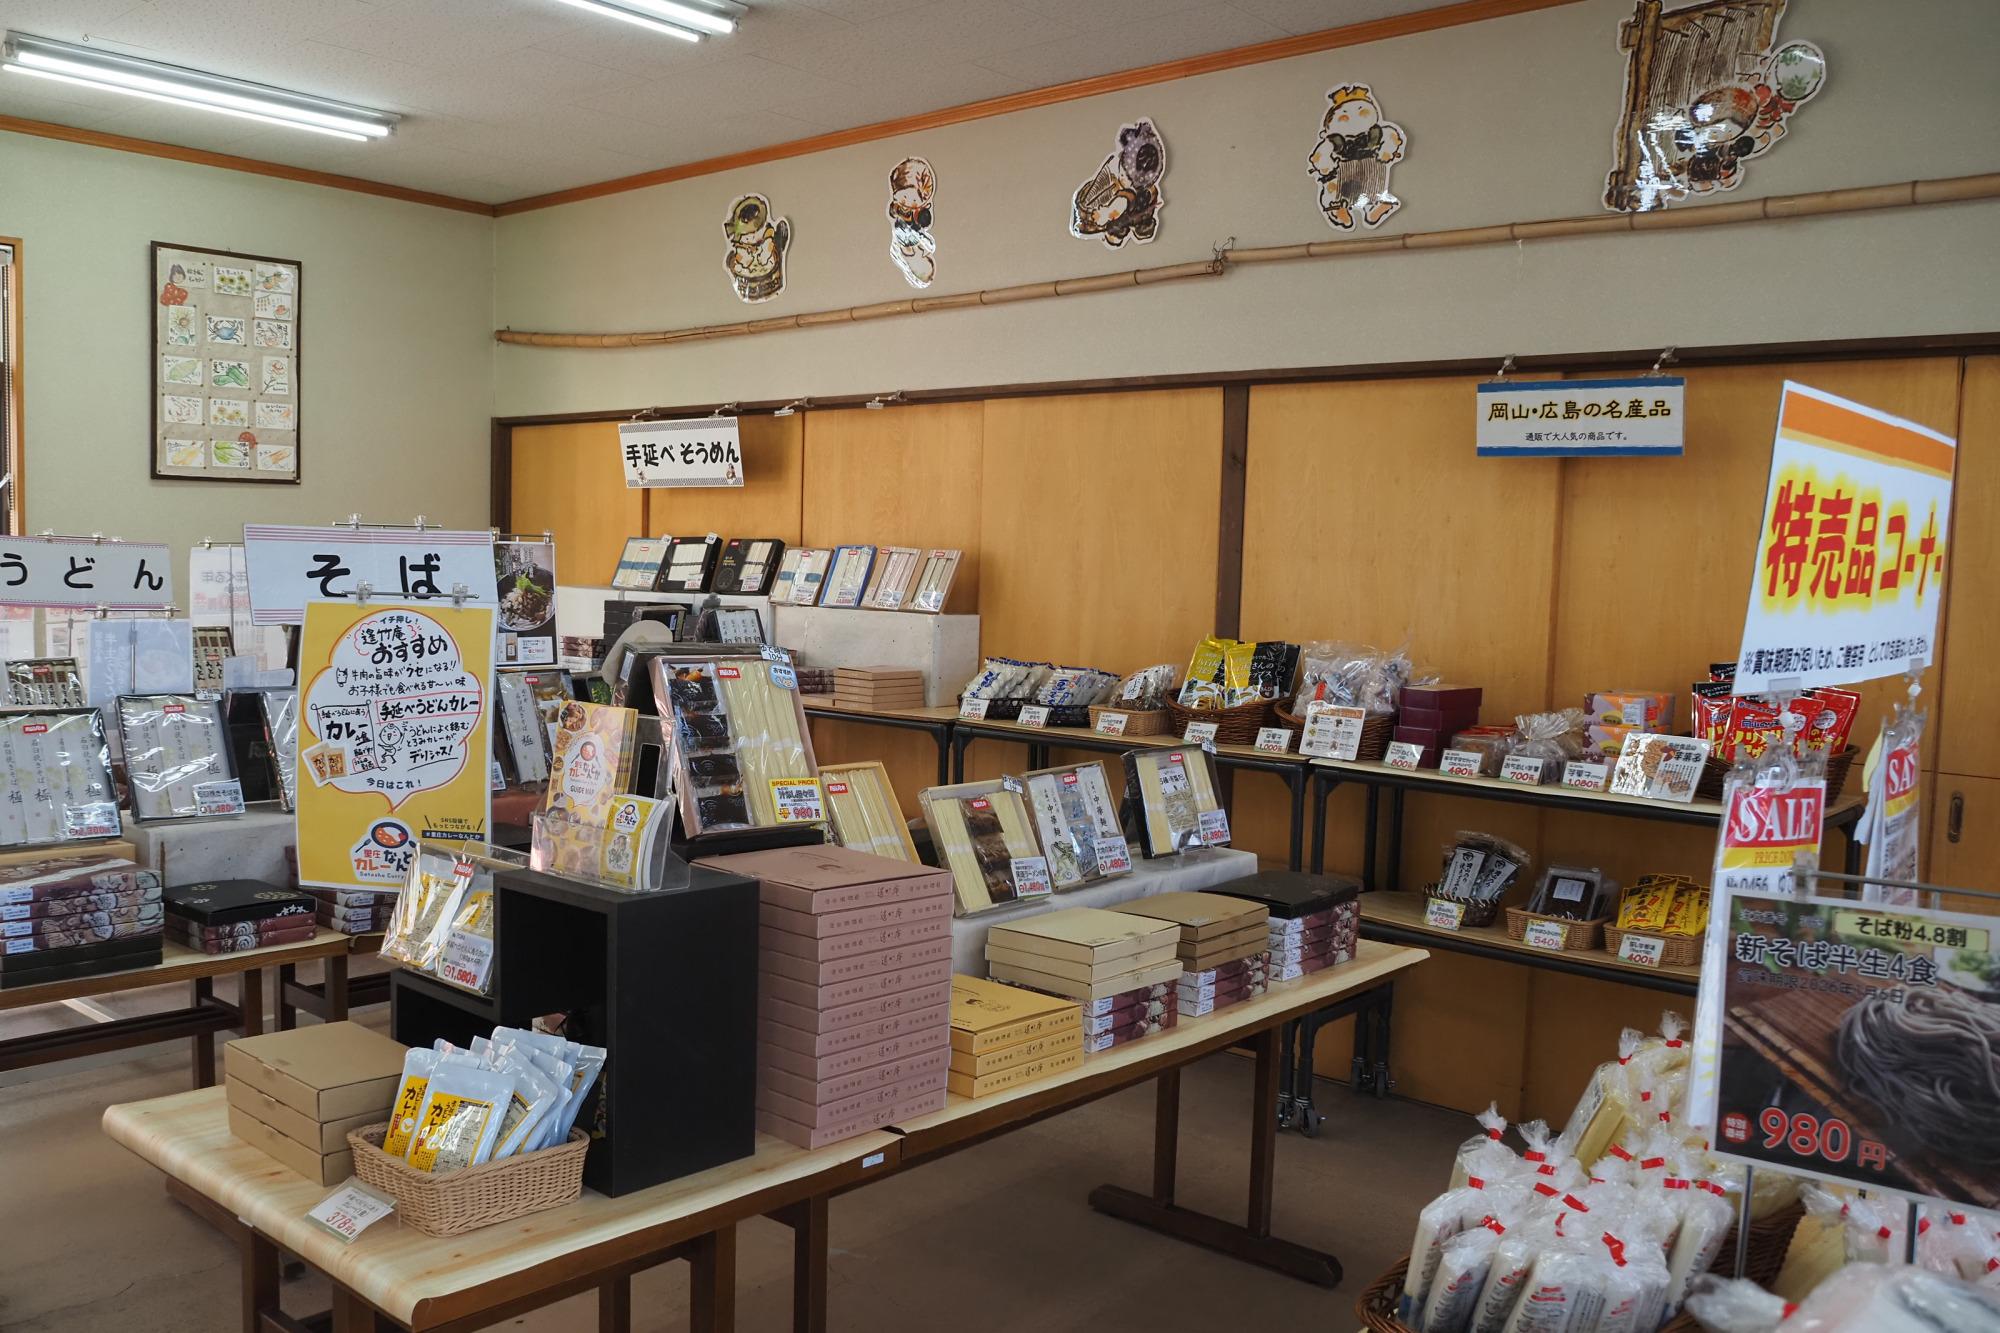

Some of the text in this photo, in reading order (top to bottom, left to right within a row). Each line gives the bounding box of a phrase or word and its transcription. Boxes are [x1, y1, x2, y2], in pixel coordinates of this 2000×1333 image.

[1488, 398, 1671, 421] 岡山・広島の名産品
[1525, 431, 1628, 442] 通販で大人気の商品です。
[0, 552, 164, 591] うどん
[306, 553, 443, 599] そば
[380, 615, 419, 625] イチ押し!
[371, 635, 449, 665] おすすめ
[379, 696, 479, 721] 手延べうどんカレー
[326, 720, 369, 741] カレー
[409, 722, 469, 738] うどんによく絡む
[367, 777, 422, 790] 今日はこれ!
[792, 807, 814, 819] 980
[1734, 796, 1816, 842] SALE
[354, 858, 391, 871] カレー
[1854, 916, 1967, 947] そば粉4.8割
[1735, 933, 1937, 987] 新そば半生4食
[1759, 1106, 1886, 1171] 980 円
